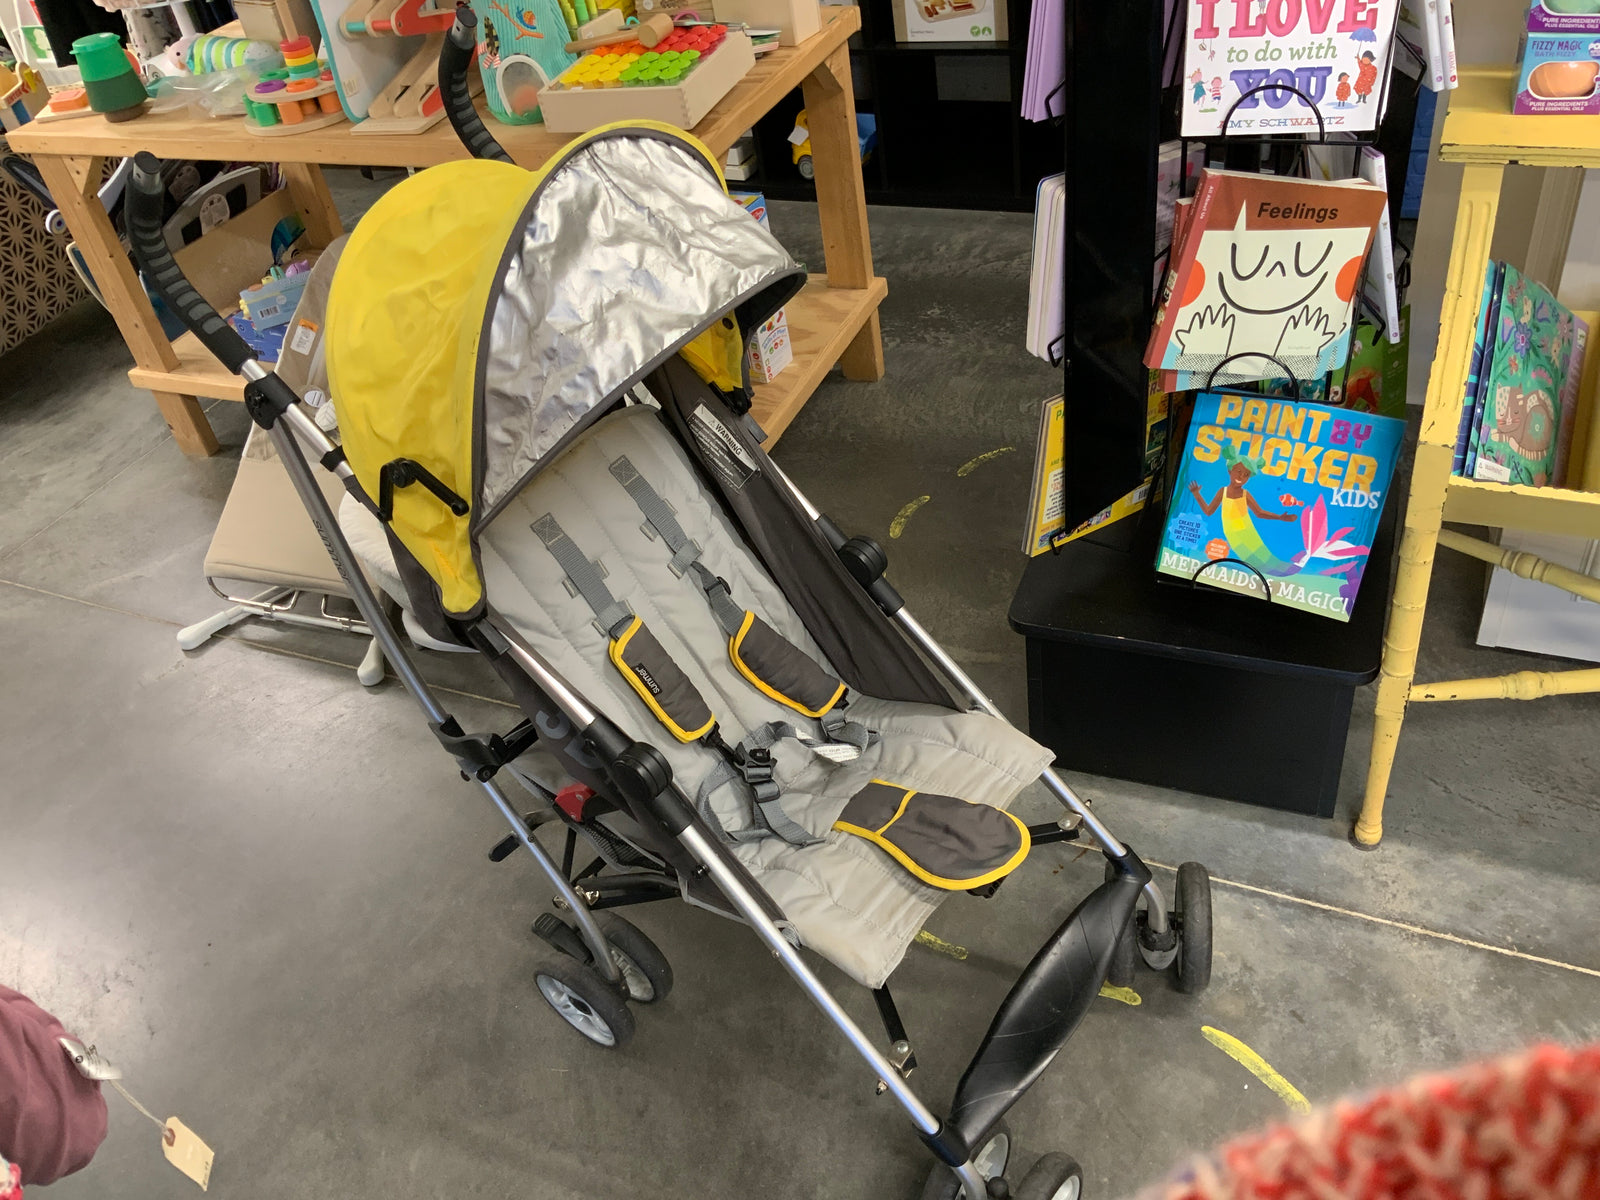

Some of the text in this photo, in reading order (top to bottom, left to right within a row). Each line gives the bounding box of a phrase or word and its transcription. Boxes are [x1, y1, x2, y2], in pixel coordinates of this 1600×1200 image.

[1229, 0, 1379, 38] LOVE
[1226, 37, 1338, 63] to do with
[1531, 40, 1555, 50] FIZZY
[1557, 40, 1583, 50] MAGIC
[1230, 66, 1333, 110] YOU
[1257, 202, 1339, 223] Feelings
[1216, 394, 1373, 449] PAINT BY
[715, 423, 743, 456] WARNING
[1193, 424, 1378, 495] STICKER
[1330, 487, 1381, 509] KIDS
[1178, 519, 1194, 527] CREATE
[313, 519, 350, 584] summer
[1162, 552, 1259, 590] MERMAIDS
[1277, 581, 1349, 614] MAGIC!
[635, 666, 661, 694] summer
